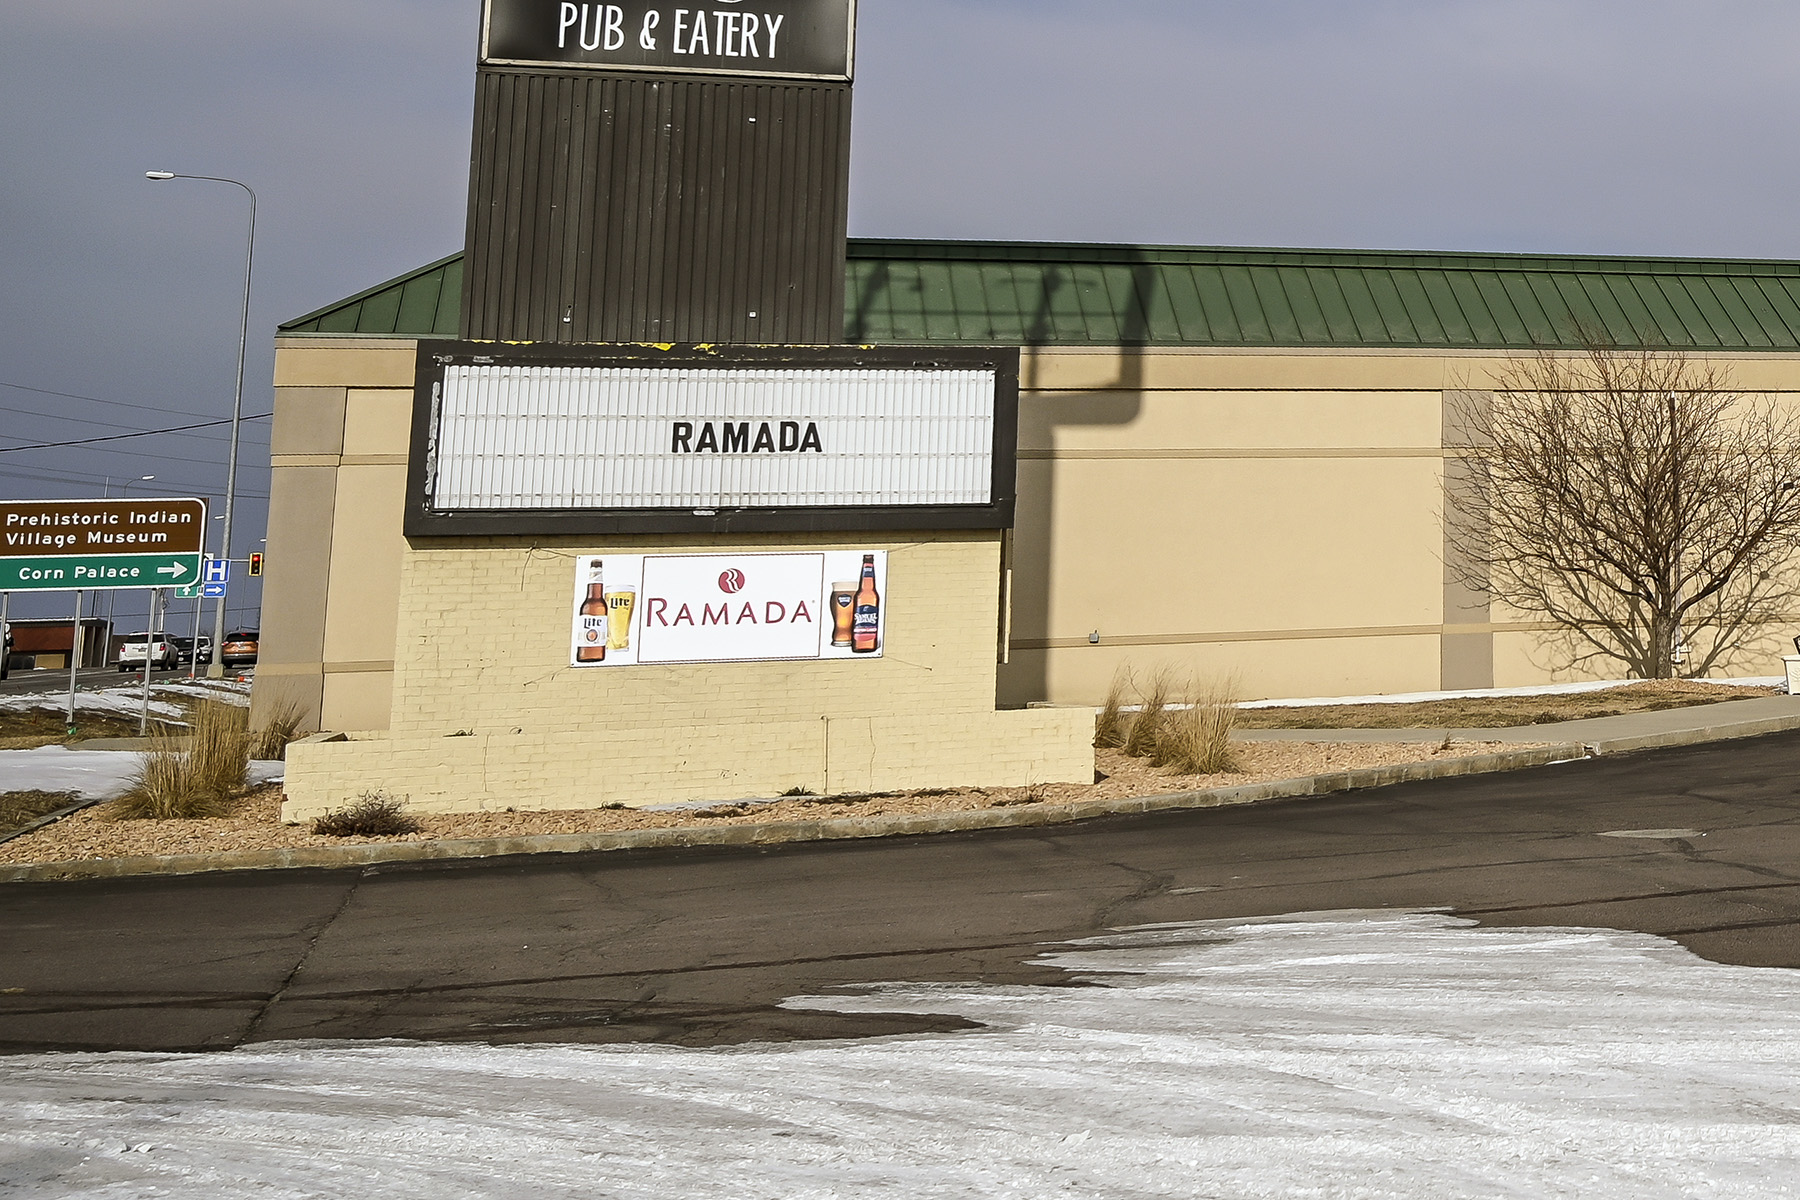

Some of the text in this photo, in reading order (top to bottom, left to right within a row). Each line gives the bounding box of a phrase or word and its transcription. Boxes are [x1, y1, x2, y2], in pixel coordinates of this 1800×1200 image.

[558, 1, 785, 59] PUB & EATERY
[671, 421, 823, 454] RAMADA
[6, 510, 191, 526] Prehistoric Indian
[6, 531, 167, 549] Village Museum
[18, 565, 140, 580] Corn Palace
[206, 560, 226, 581] H
[610, 597, 630, 609] Lite
[646, 597, 812, 628] RAMADA
[583, 618, 602, 629] Lite
